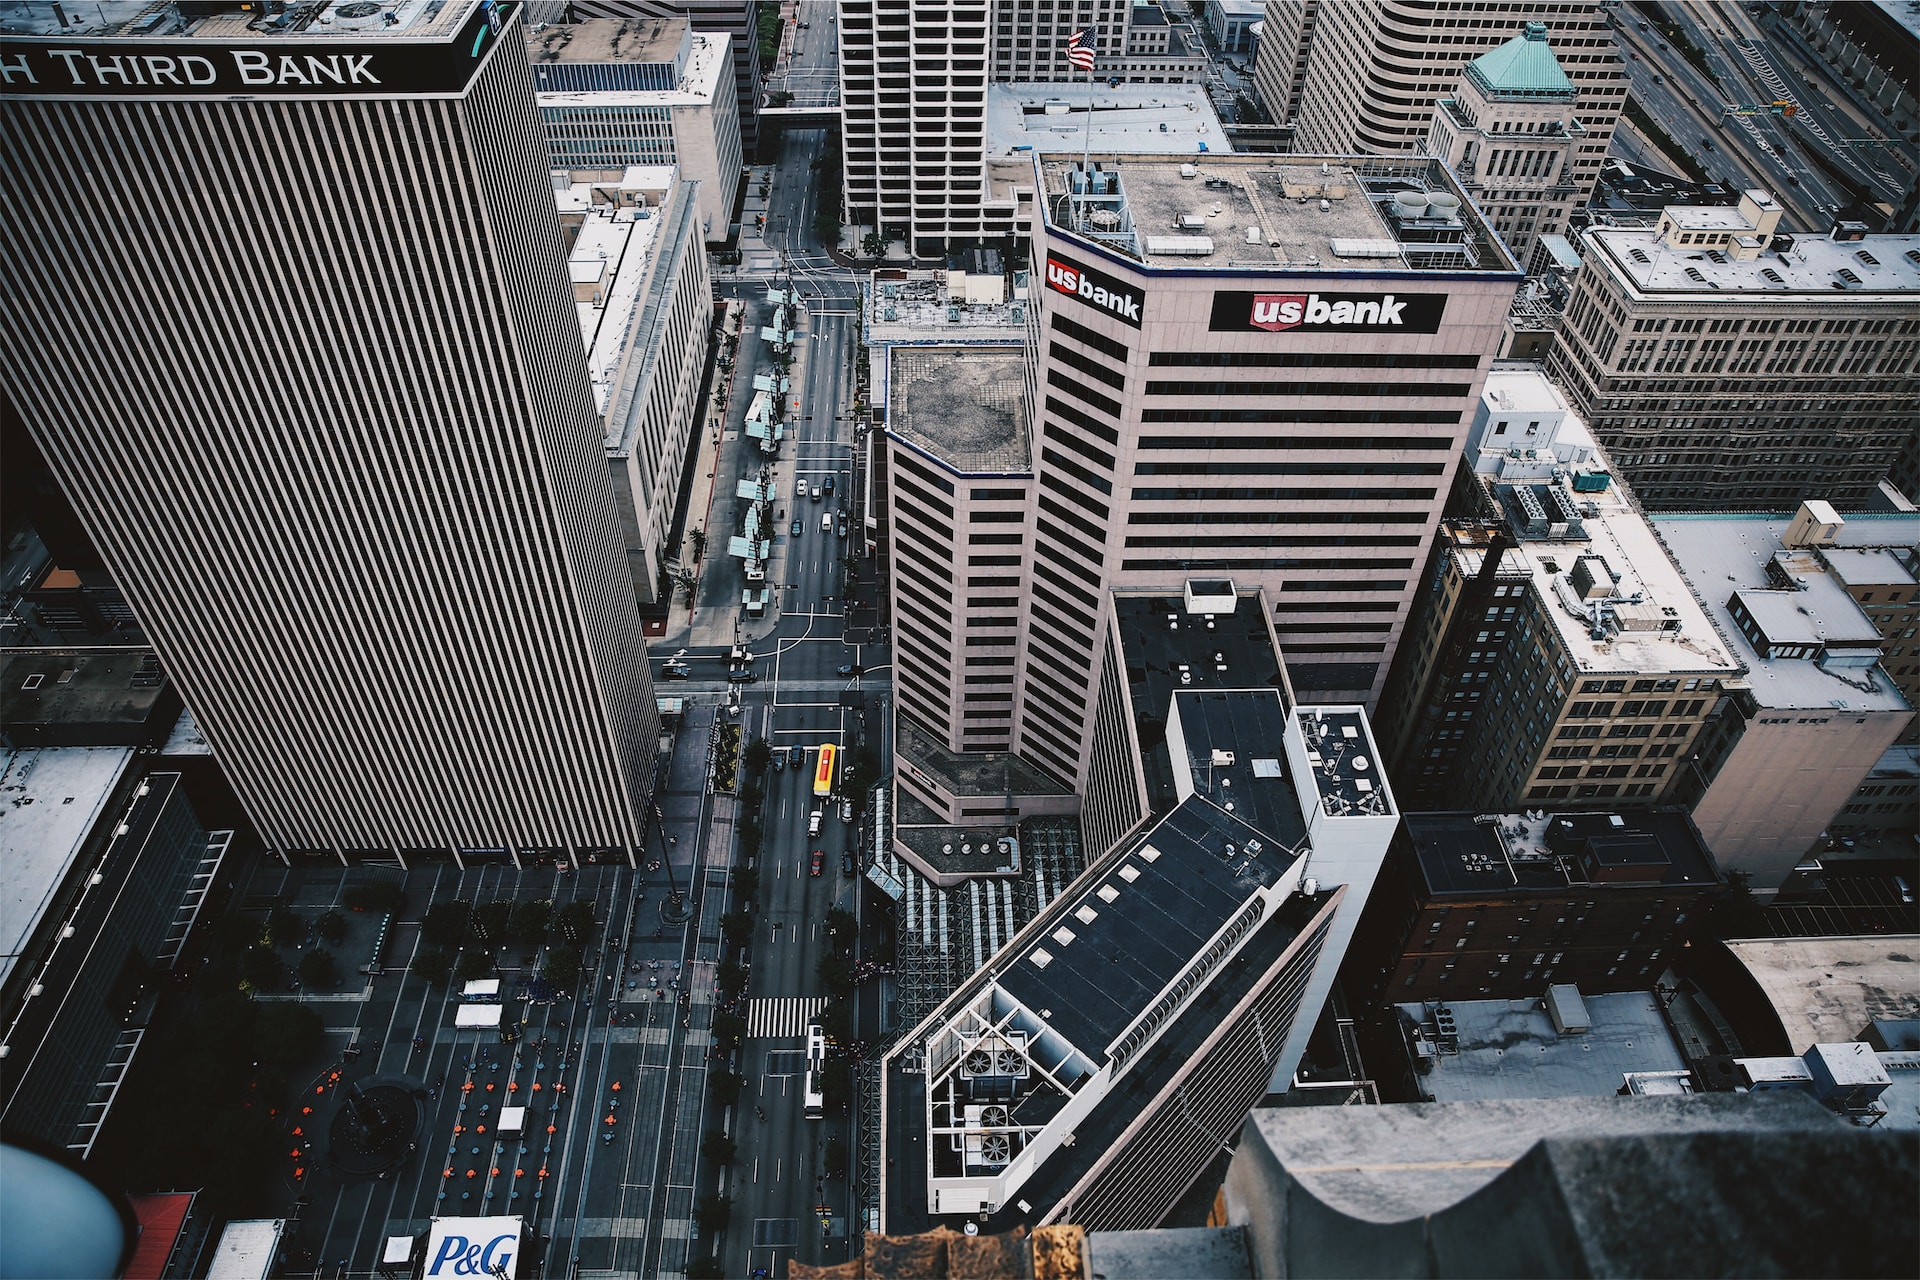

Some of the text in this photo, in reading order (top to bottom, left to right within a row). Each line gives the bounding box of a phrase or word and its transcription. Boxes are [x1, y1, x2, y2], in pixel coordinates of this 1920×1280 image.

[47, 49, 217, 85] THIRD
[229, 50, 382, 85] BANK
[427, 1234, 518, 1276] P&G
